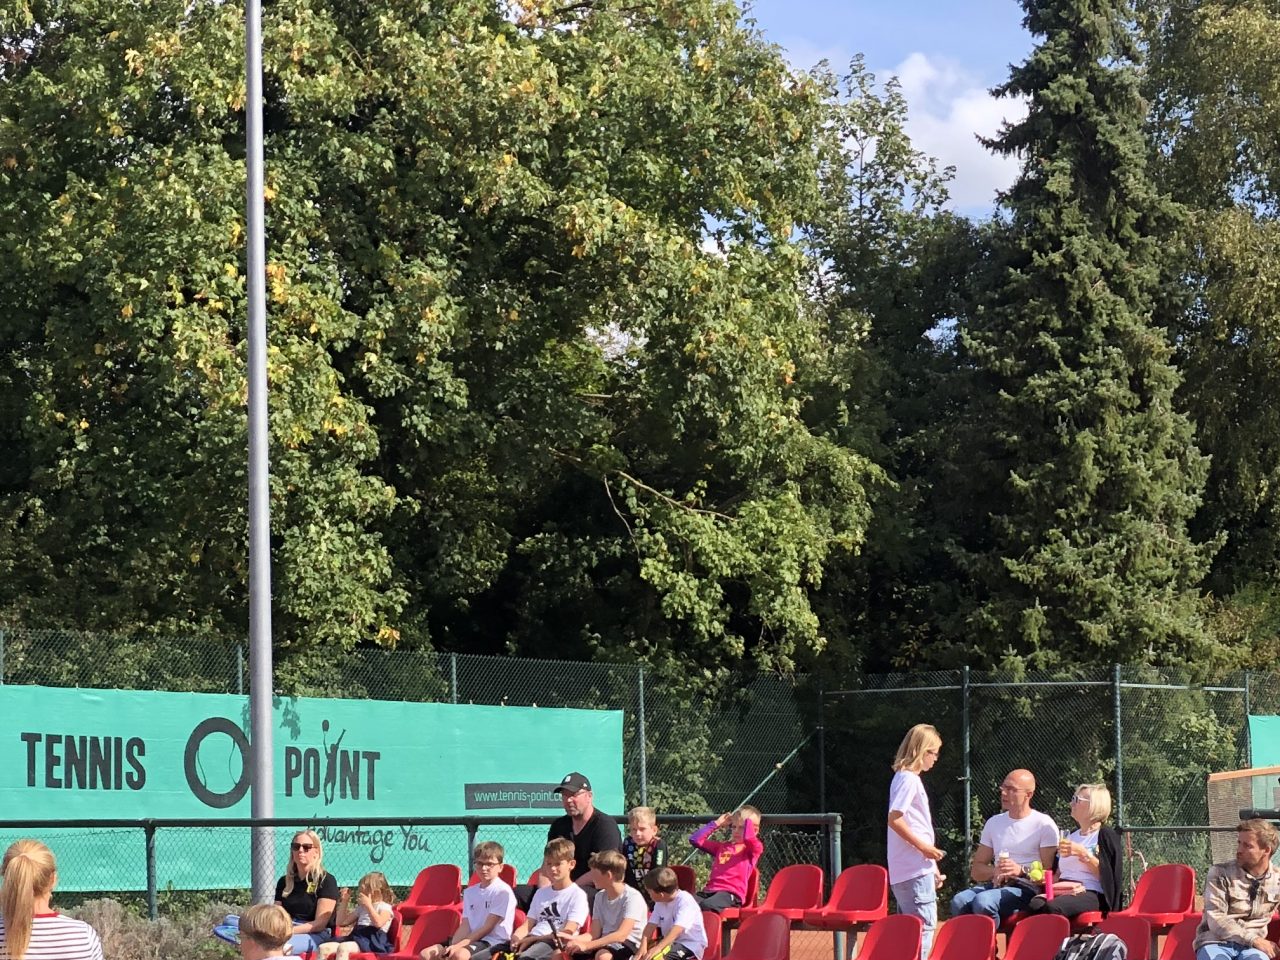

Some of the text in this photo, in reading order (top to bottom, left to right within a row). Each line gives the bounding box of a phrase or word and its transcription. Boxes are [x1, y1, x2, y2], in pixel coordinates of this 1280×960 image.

[20, 731, 381, 805] TENNIS POINT
[400, 825, 433, 853] You
